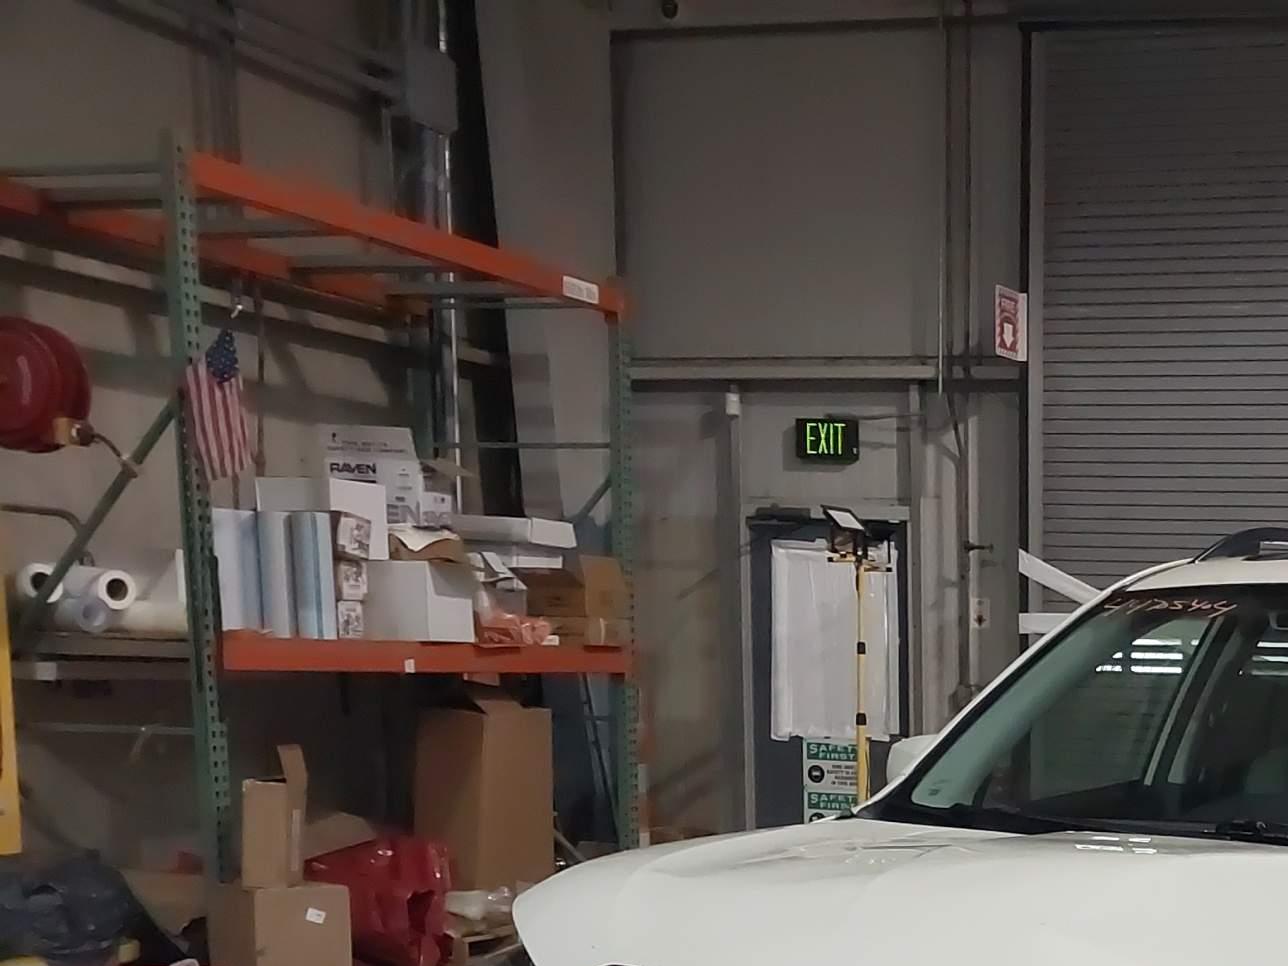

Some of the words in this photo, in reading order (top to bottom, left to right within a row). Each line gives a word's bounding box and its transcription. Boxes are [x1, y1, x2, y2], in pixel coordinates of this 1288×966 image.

[806, 422, 847, 455] EXIT
[329, 462, 377, 475] RAVEN
[809, 743, 857, 754] SAFET
[810, 793, 856, 804] SAFET
